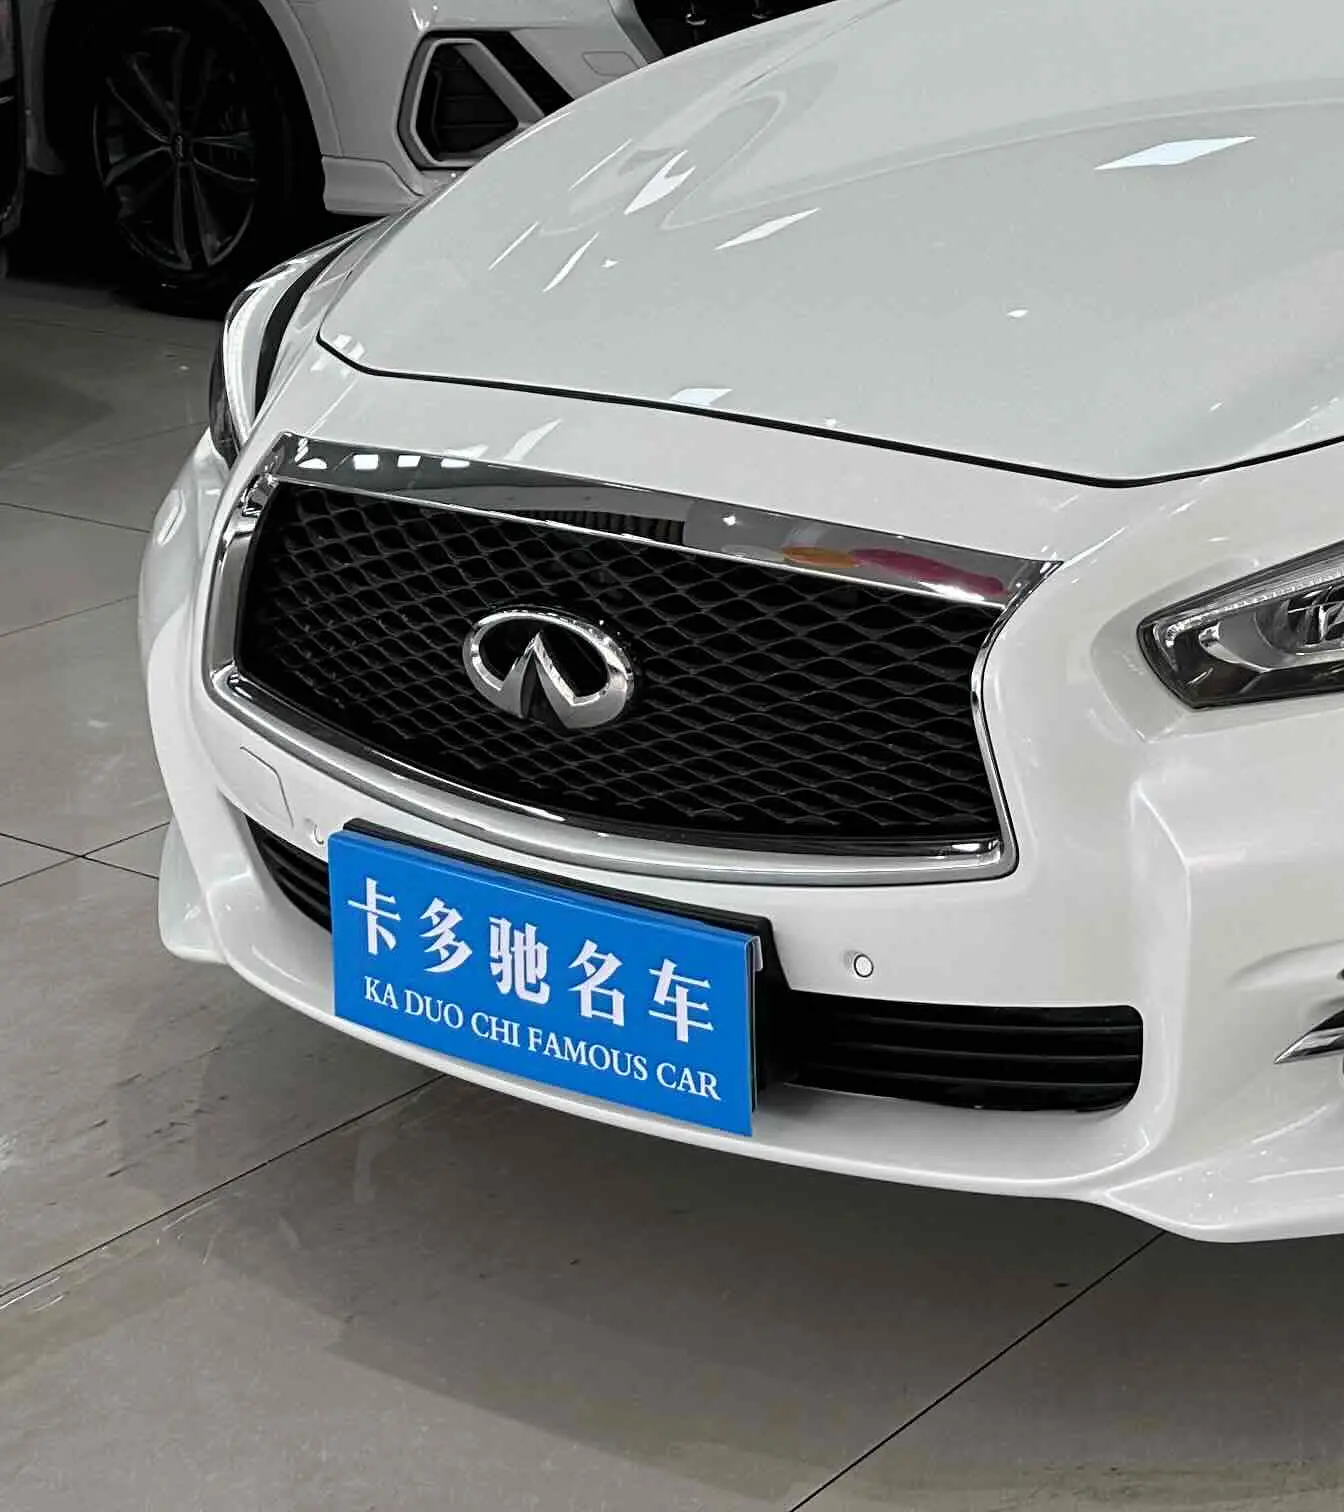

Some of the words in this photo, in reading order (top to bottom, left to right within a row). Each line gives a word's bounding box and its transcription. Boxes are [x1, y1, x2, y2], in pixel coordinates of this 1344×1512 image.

[347, 876, 715, 1044] 卡多驰名车
[363, 975, 399, 1010] KA
[404, 989, 464, 1030] DUO
[471, 1011, 521, 1048] CHI
[528, 1028, 649, 1082] FAMOUS
[656, 1061, 721, 1101] CAR
